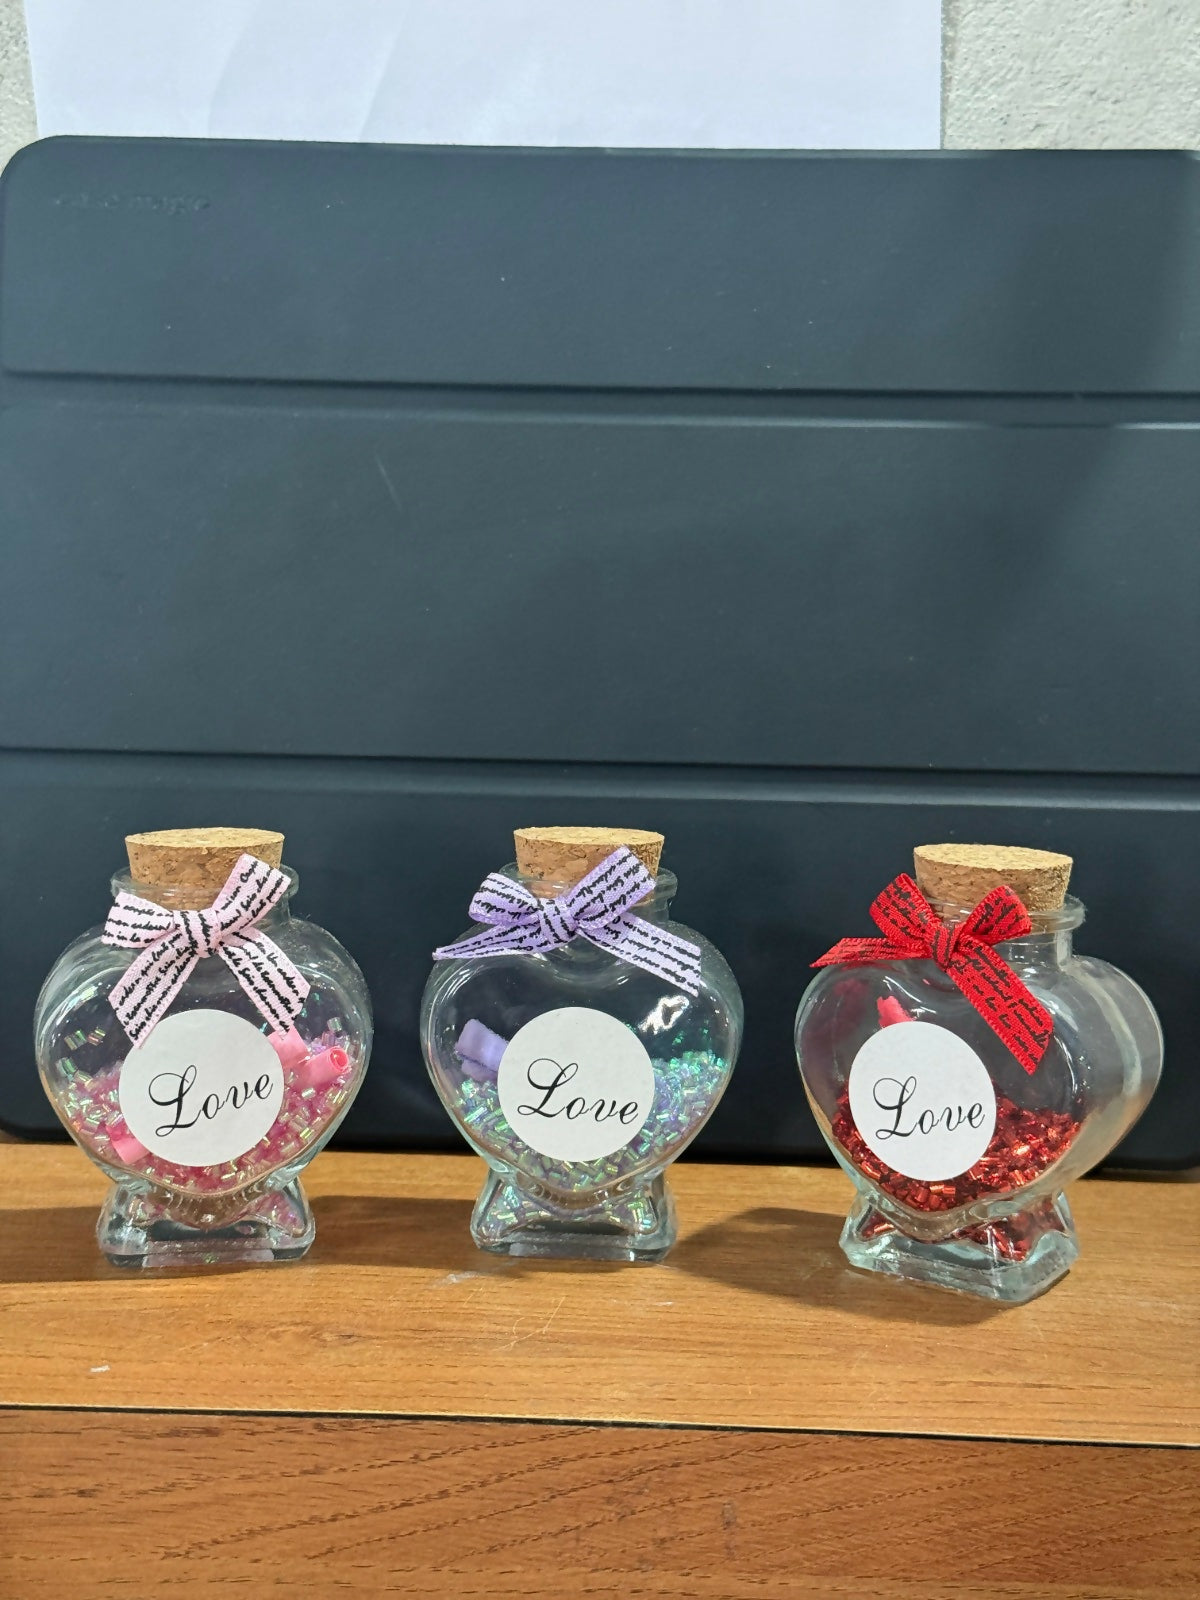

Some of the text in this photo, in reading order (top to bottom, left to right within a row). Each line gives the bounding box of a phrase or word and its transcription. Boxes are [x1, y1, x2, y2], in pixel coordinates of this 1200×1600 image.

[148, 1064, 274, 1137] Love
[517, 1058, 639, 1125] Love
[873, 1075, 986, 1140] Love
